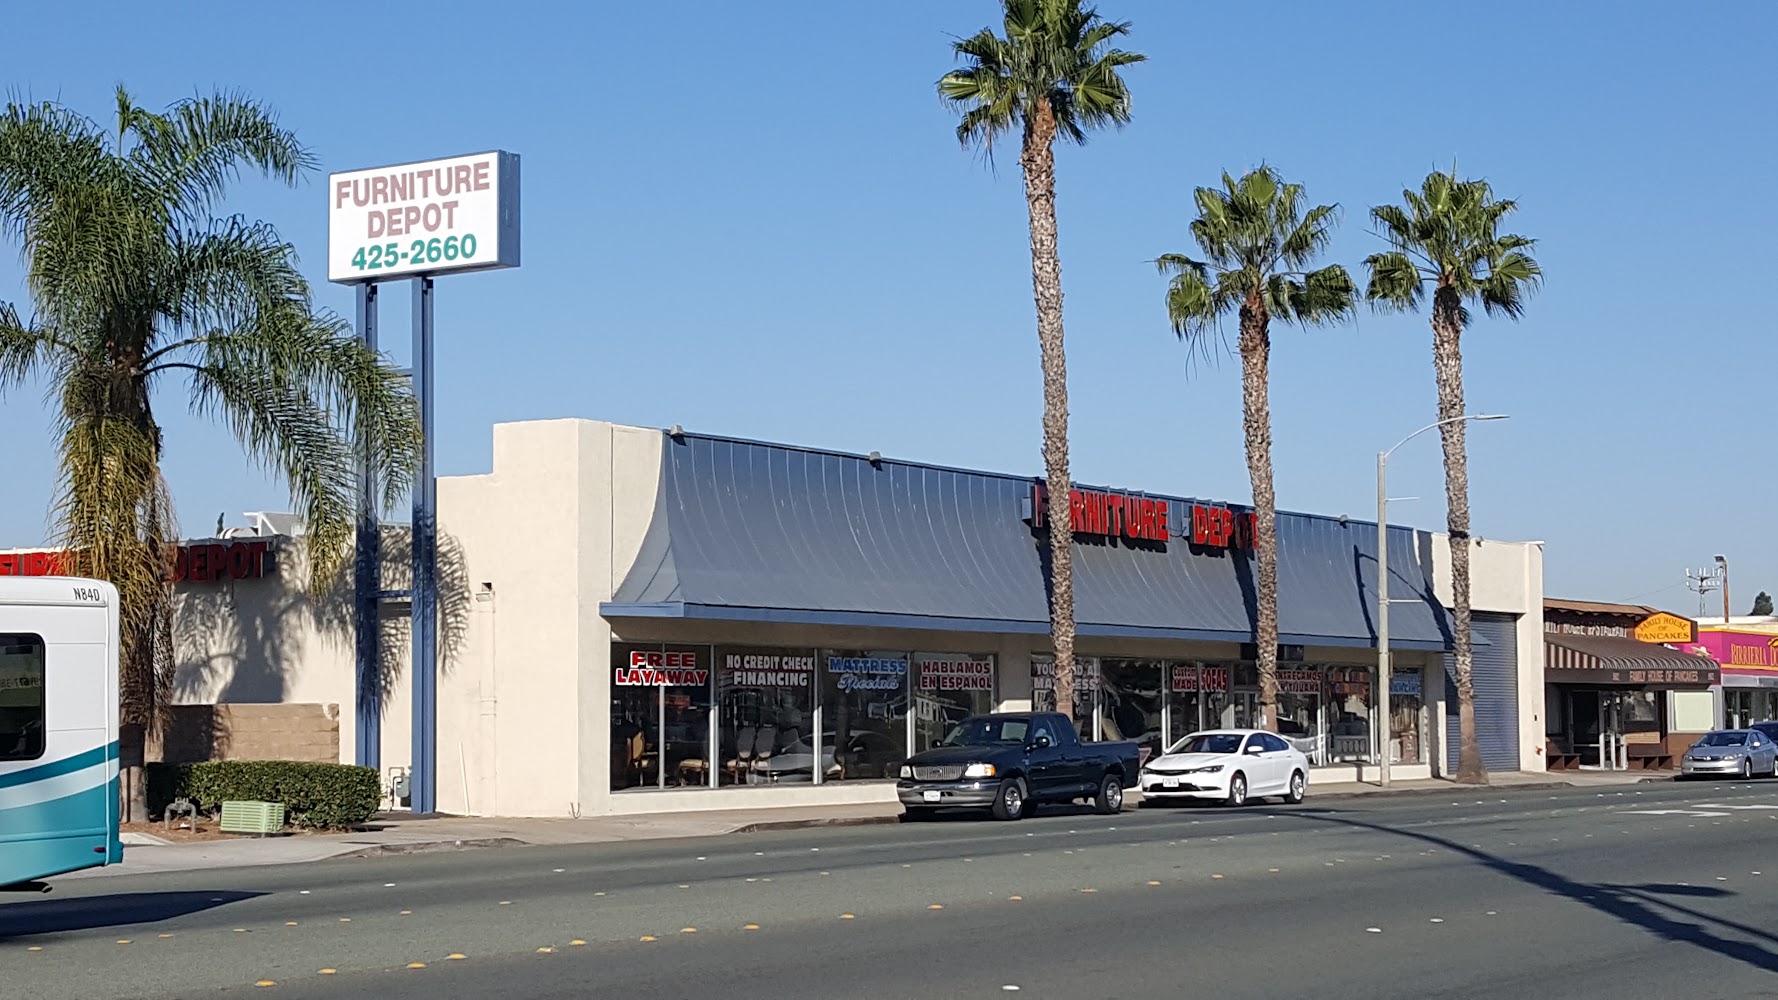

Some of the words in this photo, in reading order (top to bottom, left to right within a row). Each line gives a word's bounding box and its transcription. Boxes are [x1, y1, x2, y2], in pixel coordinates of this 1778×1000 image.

[336, 161, 490, 209] FURNITURE
[367, 200, 459, 239] DEPOT
[351, 233, 477, 271] 425-2660
[1034, 484, 1169, 542] FRNITURE
[1639, 616, 1661, 632] FAMILY
[1663, 616, 1689, 631] HOUSE
[1637, 632, 1690, 640] PANCAKES
[630, 651, 696, 669] FREE
[726, 655, 741, 669] NO
[743, 655, 780, 670] CREDIT
[782, 656, 814, 671] CHECK
[1730, 643, 1768, 666] BIRRIERIA
[828, 657, 909, 675] MATTRESS
[921, 659, 992, 676] HABLAMOS
[615, 668, 709, 687] LAYAWAY
[733, 672, 808, 687] FINANCING
[837, 673, 900, 693] Specials
[919, 675, 938, 690] EN
[1033, 677, 1098, 690] MAESS
[1200, 667, 1228, 693] SOFAS
[1647, 670, 1664, 682] HOUSE
[1665, 670, 1673, 682] OF
[1172, 679, 1198, 692] MADE
